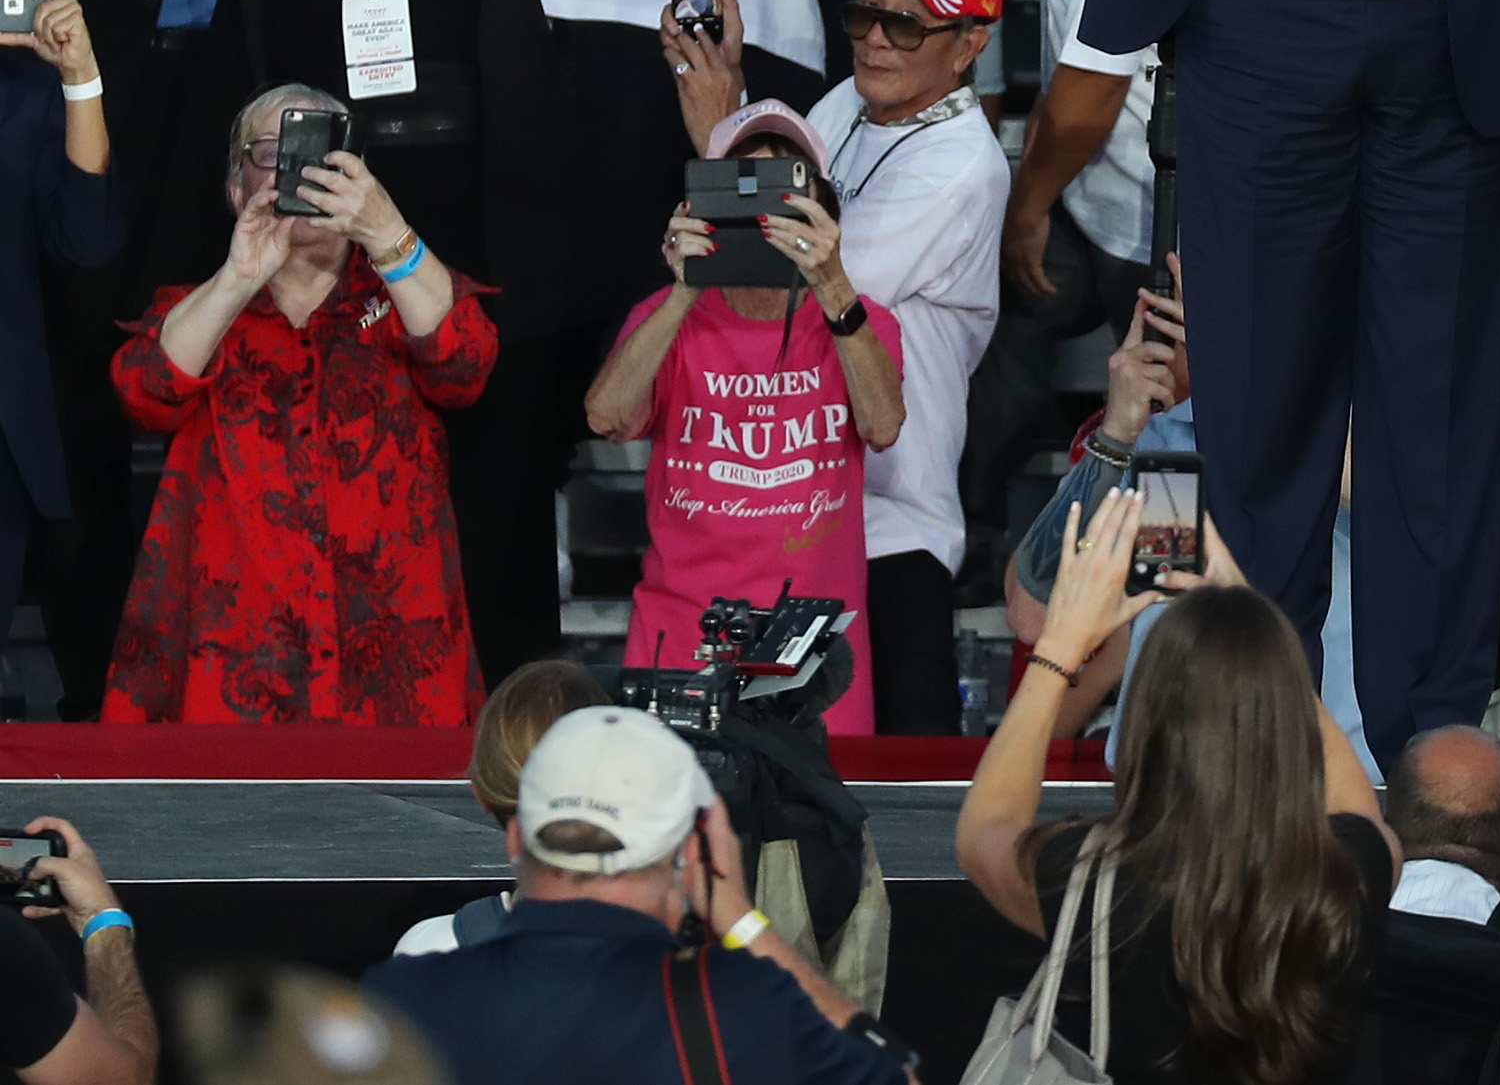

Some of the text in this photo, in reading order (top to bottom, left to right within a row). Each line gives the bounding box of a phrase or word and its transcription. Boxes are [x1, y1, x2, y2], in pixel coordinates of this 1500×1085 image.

[703, 366, 821, 398] WOMEN
[748, 404, 775, 416] FOR
[680, 404, 849, 460] TRUMP
[718, 464, 805, 485] TRUMP 2020
[665, 486, 704, 520] Keep
[707, 497, 805, 518] America
